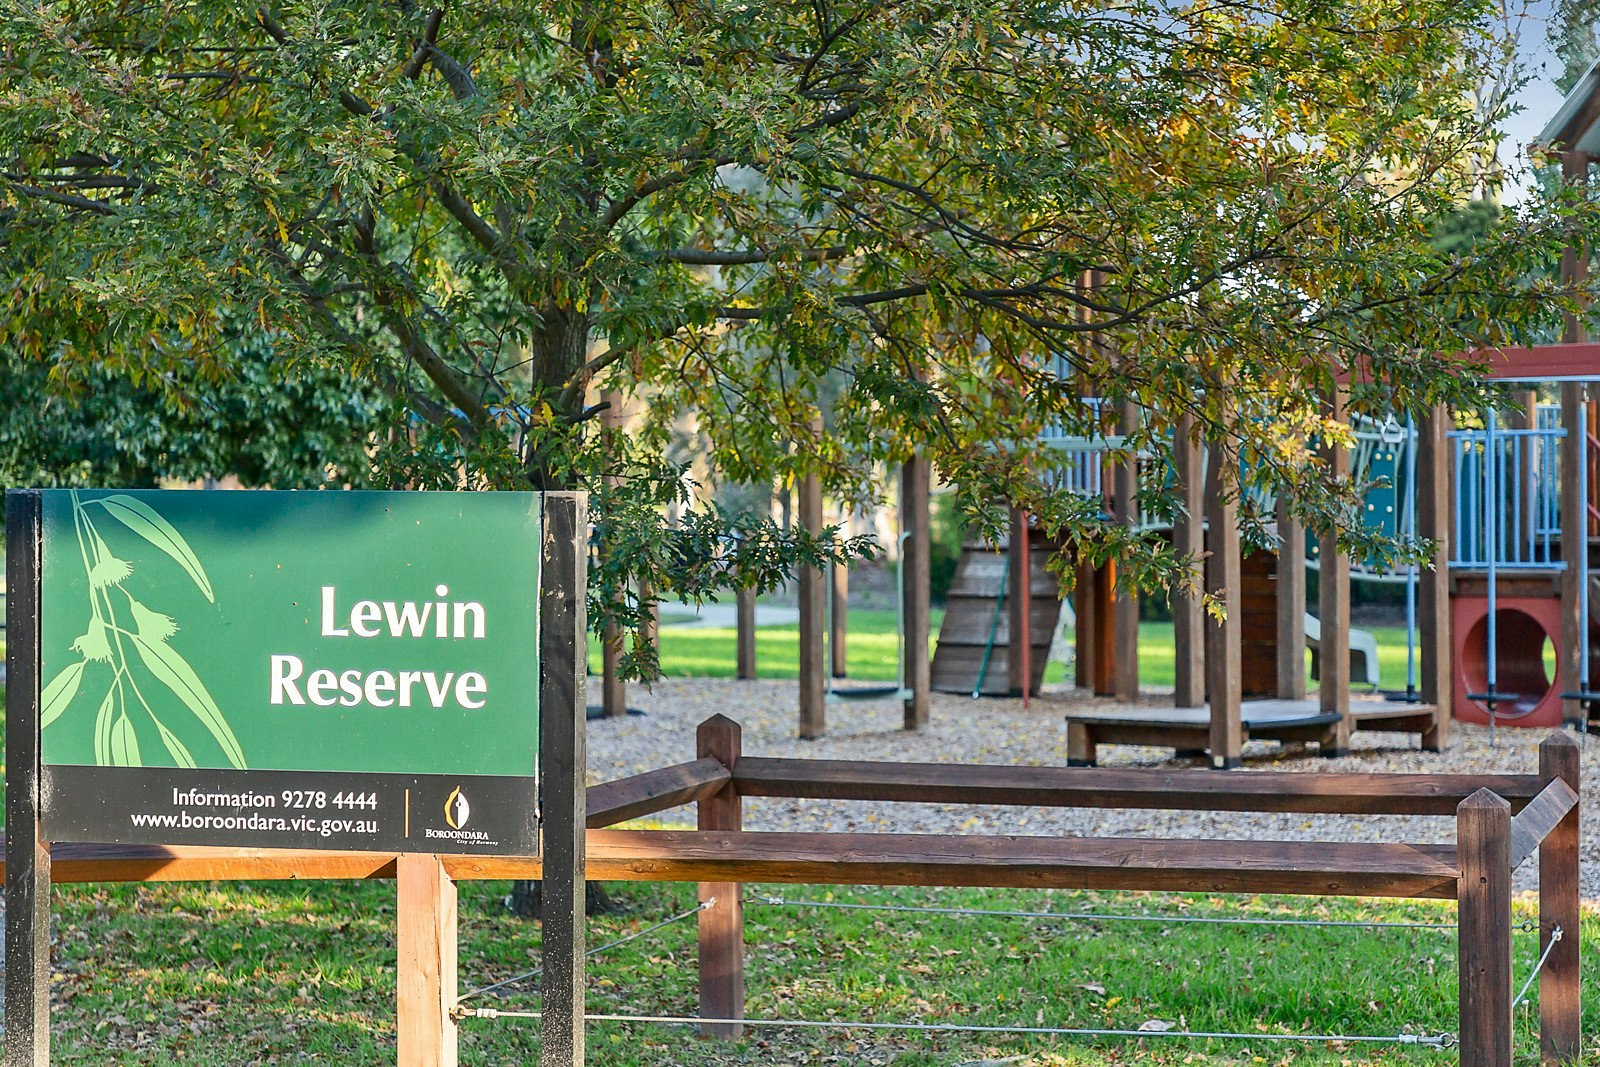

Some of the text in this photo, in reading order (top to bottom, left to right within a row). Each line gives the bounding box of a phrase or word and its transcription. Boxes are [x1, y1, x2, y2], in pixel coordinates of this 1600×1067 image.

[321, 584, 486, 639] Lewin
[270, 654, 488, 709] Reserve
[172, 788, 378, 810] Information 9278 4444
[130, 811, 378, 837] www.boroondara.vic.gov.au
[425, 829, 489, 840] BOROONDARA
